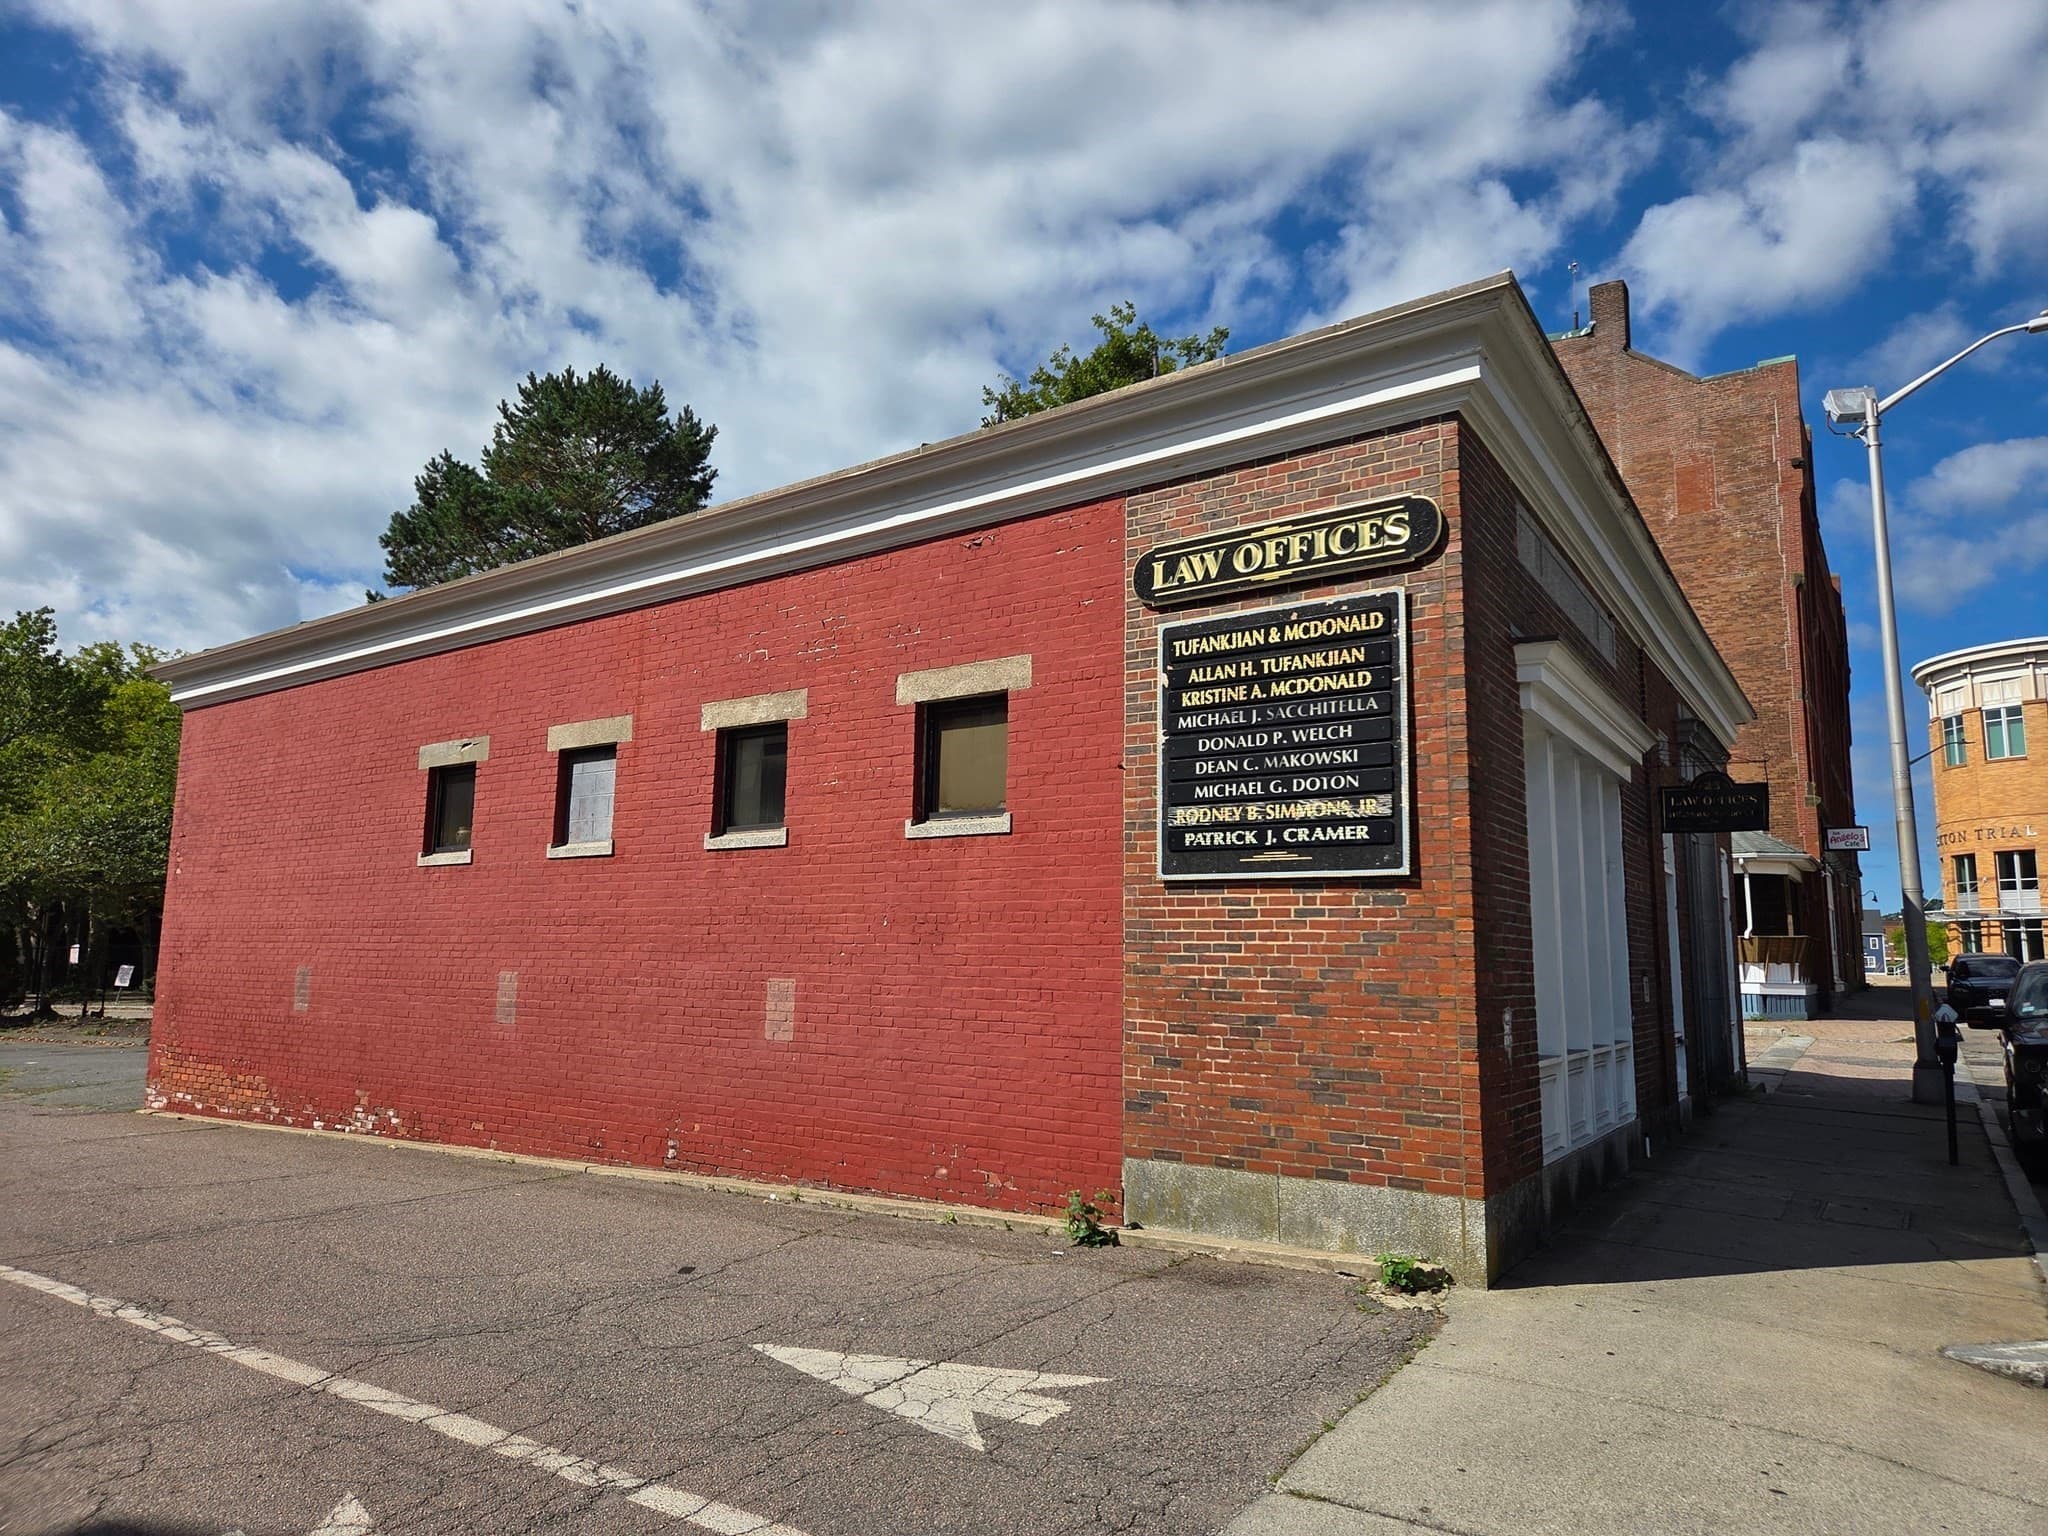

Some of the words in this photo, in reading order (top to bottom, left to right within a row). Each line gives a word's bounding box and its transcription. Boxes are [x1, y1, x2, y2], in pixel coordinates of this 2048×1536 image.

[1151, 550, 1225, 590] LAW
[1232, 511, 1411, 573] OFFICES
[1172, 629, 1265, 657] TUFANKJIAN
[1268, 626, 1281, 644] &
[1284, 611, 1384, 642] MCDONALD
[1188, 663, 1237, 684] ALLAN
[1240, 662, 1257, 677] H.
[1261, 647, 1365, 673] TUFANKJIAN
[1181, 686, 1247, 707] KRISTINE
[1251, 684, 1267, 700] A.
[1270, 671, 1372, 696] MCDONALD
[1178, 710, 1246, 729] MICHAEL
[1250, 709, 1262, 725] J.
[1266, 697, 1378, 721] SACCHITELLA
[1198, 733, 1268, 752] DONALD
[1273, 732, 1288, 745] P.
[1291, 724, 1353, 743] WELCH
[1195, 759, 1239, 776] DEAN
[1243, 758, 1259, 772] C.
[1263, 749, 1359, 769] MAKOWSKI
[1194, 781, 1265, 799] MICHAEL
[1269, 780, 1287, 794] G.
[1292, 775, 1360, 792] DOTON
[1175, 805, 1241, 825] RODNEY
[1184, 829, 1258, 846] PATRICK
[1265, 829, 1277, 846] J.
[1283, 825, 1370, 843] CRAMER
[1974, 824, 2038, 840] TRIAL
